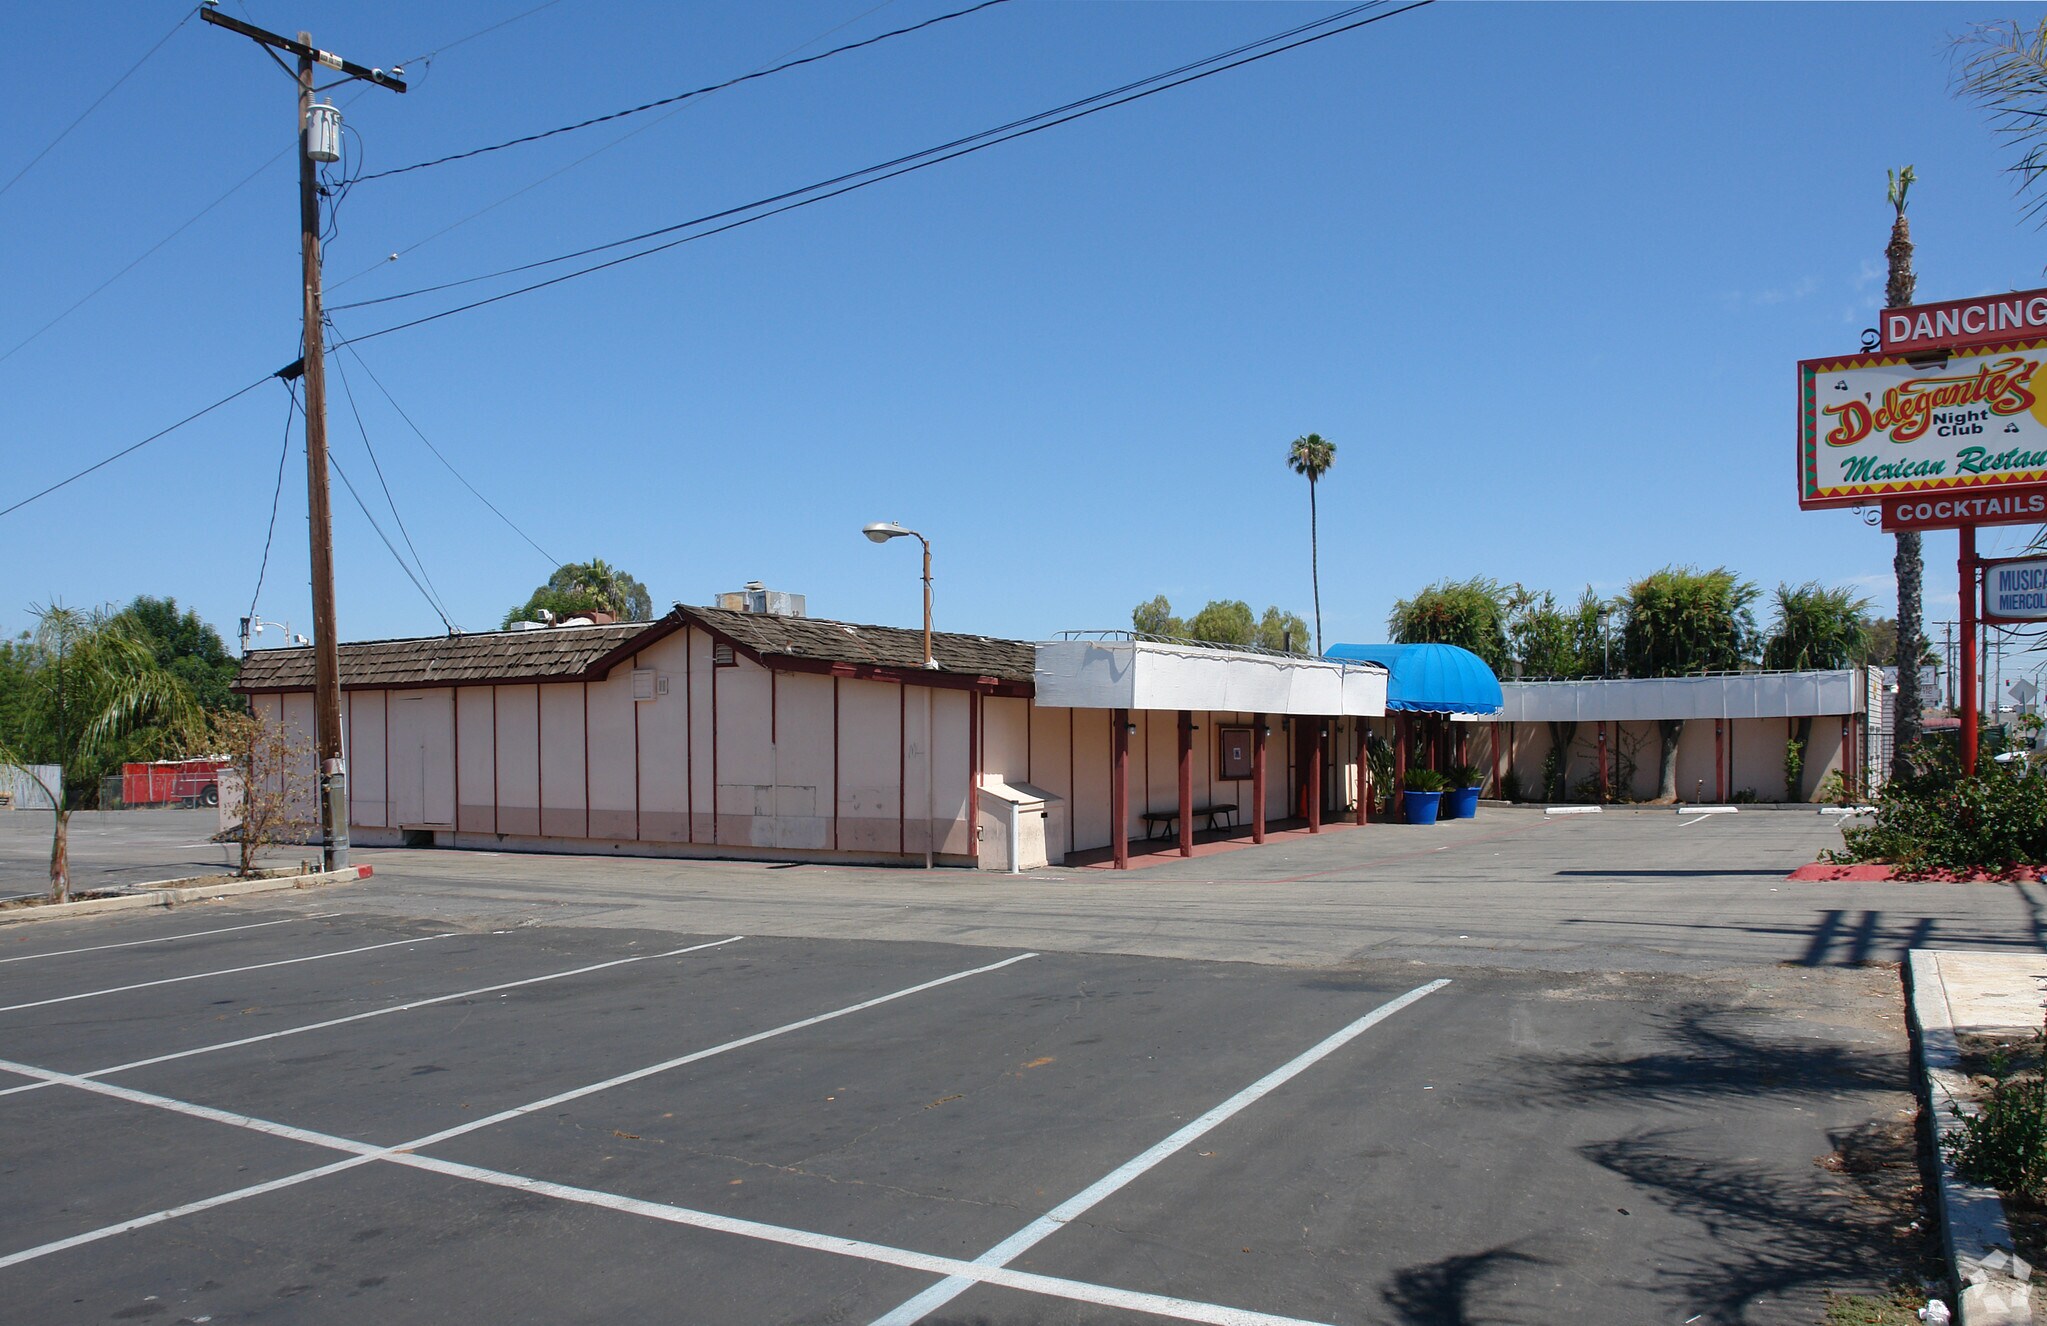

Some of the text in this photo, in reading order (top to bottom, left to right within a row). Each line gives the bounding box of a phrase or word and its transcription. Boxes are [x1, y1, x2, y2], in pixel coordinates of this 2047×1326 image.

[1932, 409, 1989, 426] Night
[1937, 424, 1984, 437] Club
[1840, 456, 1946, 483] Mexican
[1896, 494, 2045, 522] COCKTAILS
